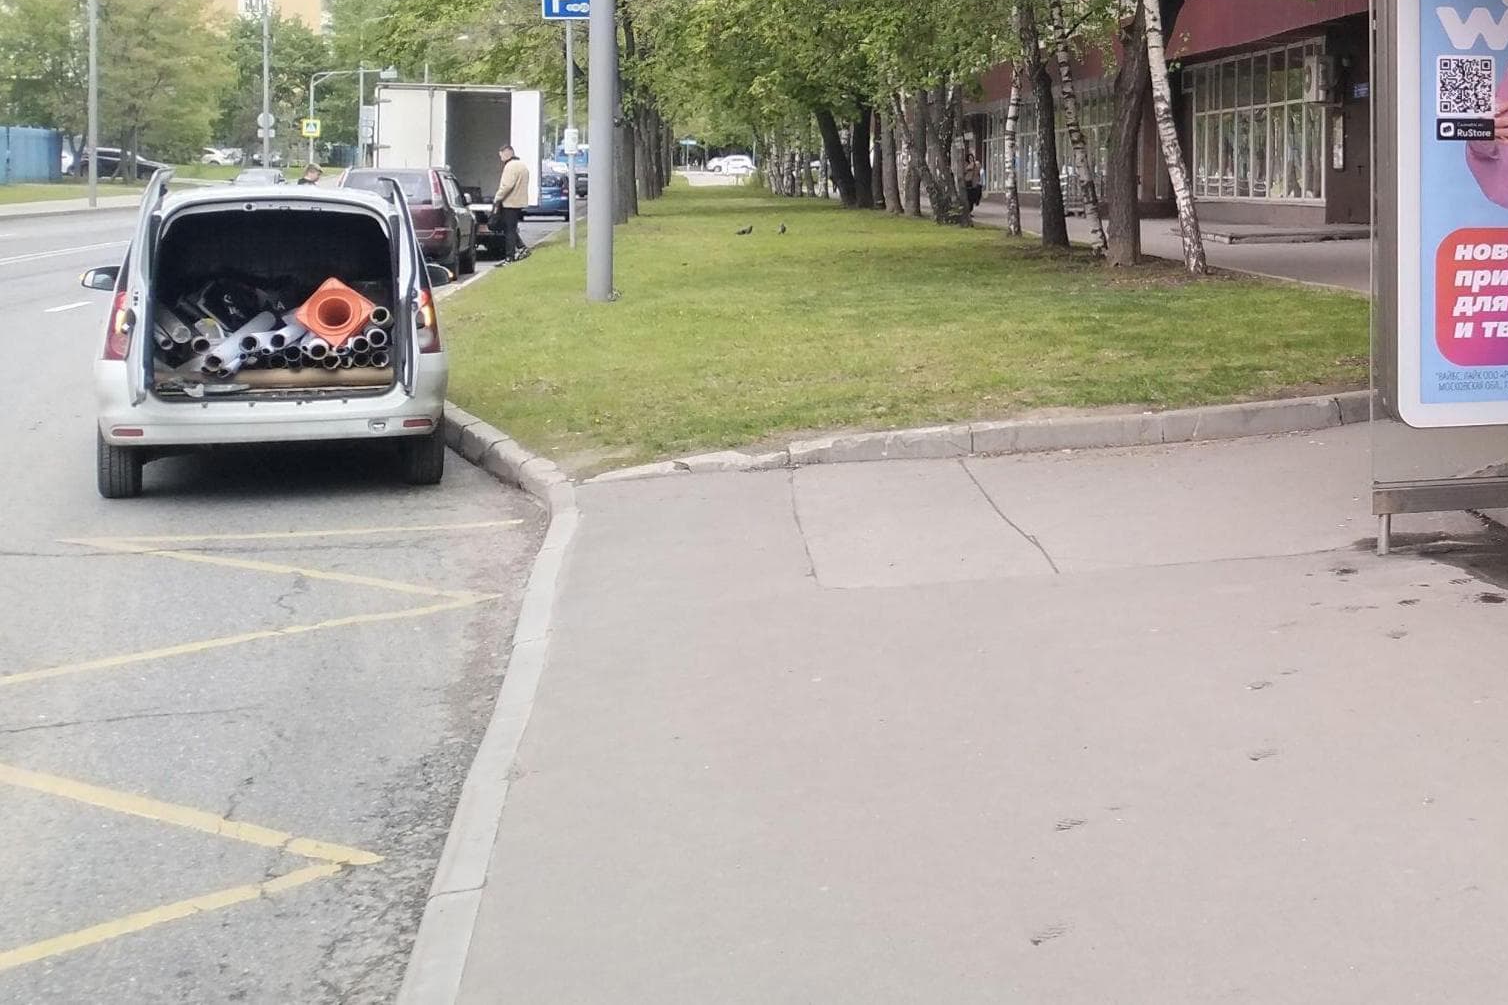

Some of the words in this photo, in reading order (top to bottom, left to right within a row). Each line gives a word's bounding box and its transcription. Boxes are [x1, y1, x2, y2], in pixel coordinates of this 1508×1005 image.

[1457, 128, 1491, 137] RuStore
[1452, 295, 1508, 317] для
[1454, 321, 1474, 338] и
